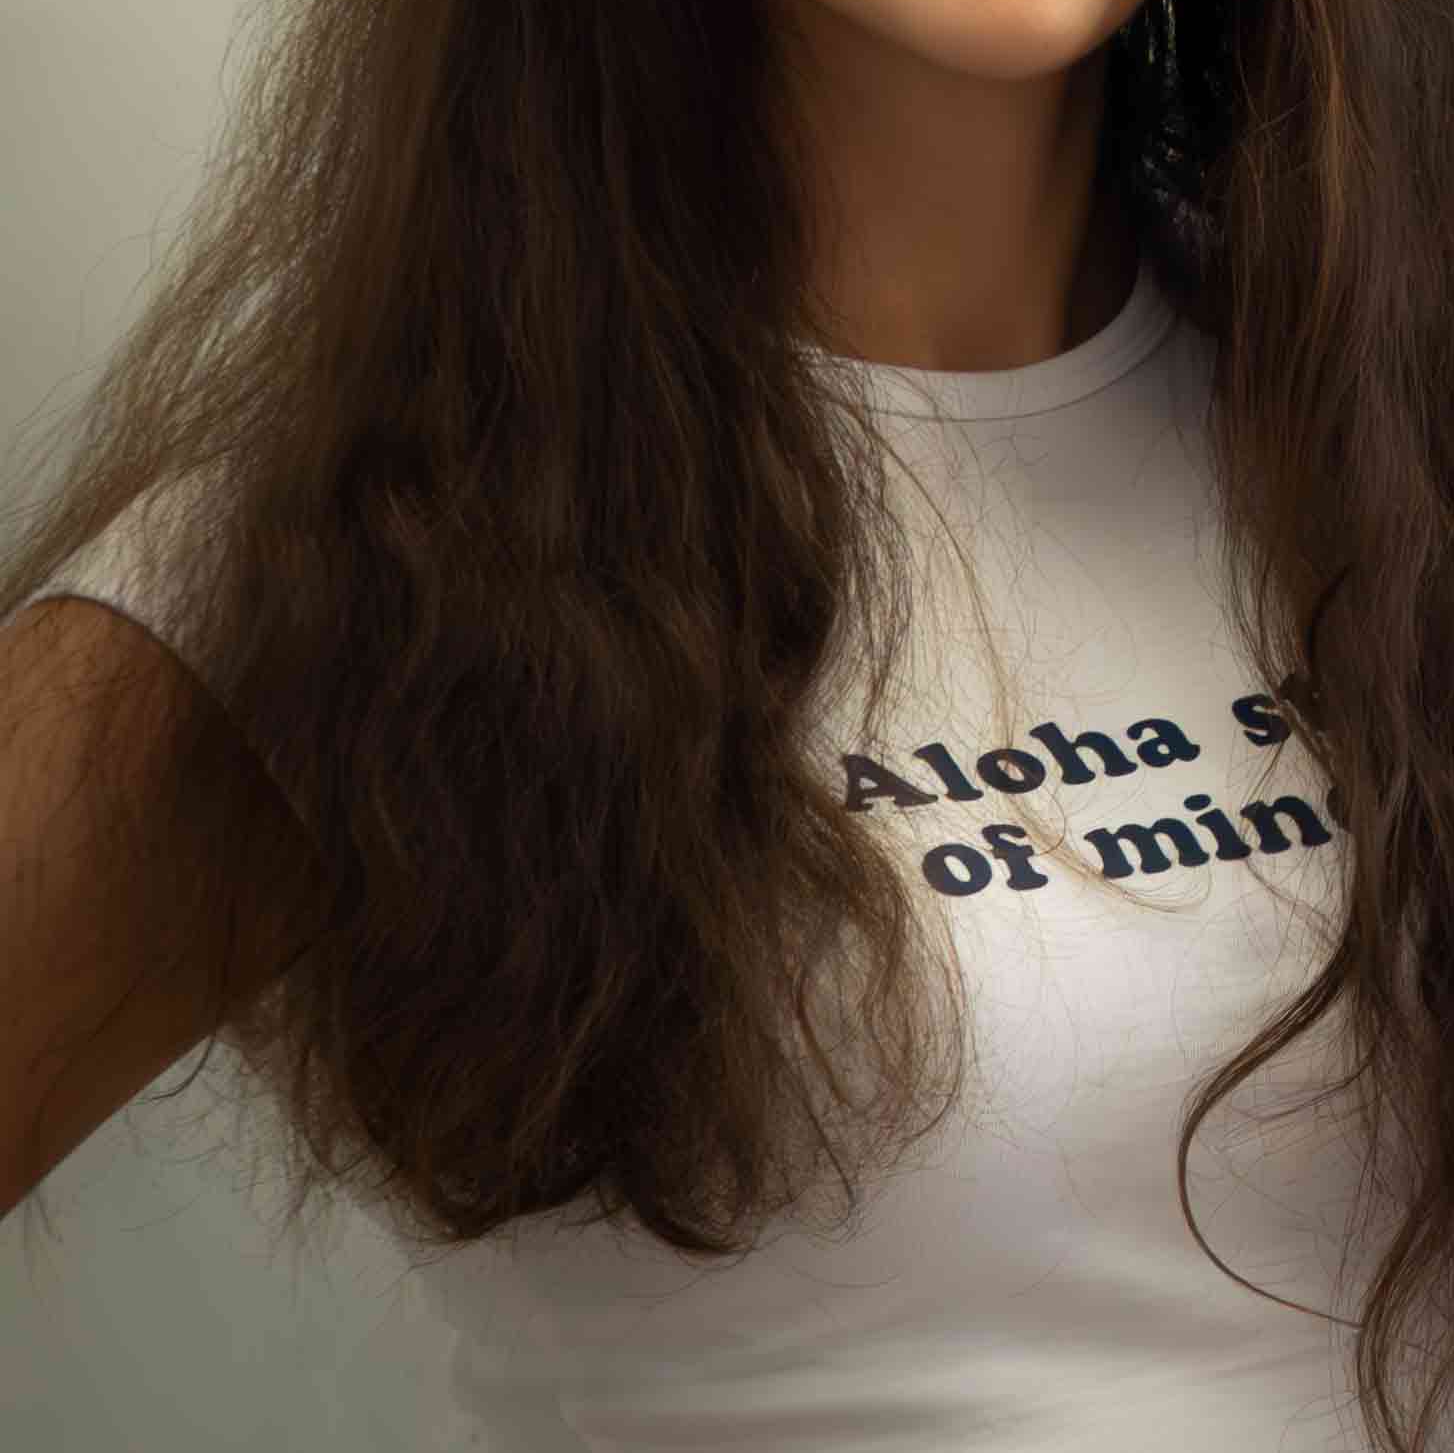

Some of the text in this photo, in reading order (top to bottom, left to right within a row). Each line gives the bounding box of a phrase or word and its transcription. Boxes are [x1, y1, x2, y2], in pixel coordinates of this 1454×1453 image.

[841, 678, 1302, 812] Aloha s
[921, 824, 1049, 897] of
